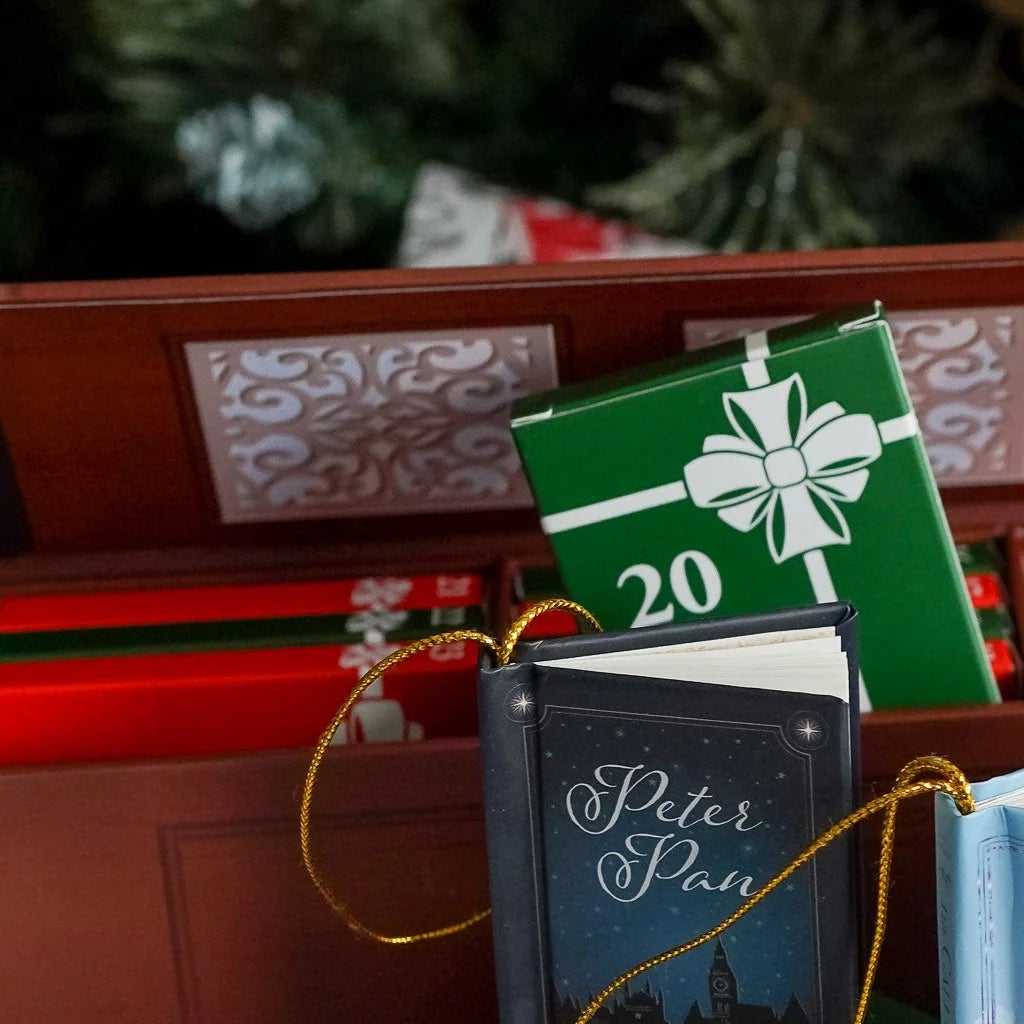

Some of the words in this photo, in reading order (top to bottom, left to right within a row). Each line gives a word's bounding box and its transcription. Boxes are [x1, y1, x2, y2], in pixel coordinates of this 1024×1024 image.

[616, 549, 722, 629] 20
[566, 764, 764, 835] Peter
[597, 833, 761, 903] Pan
